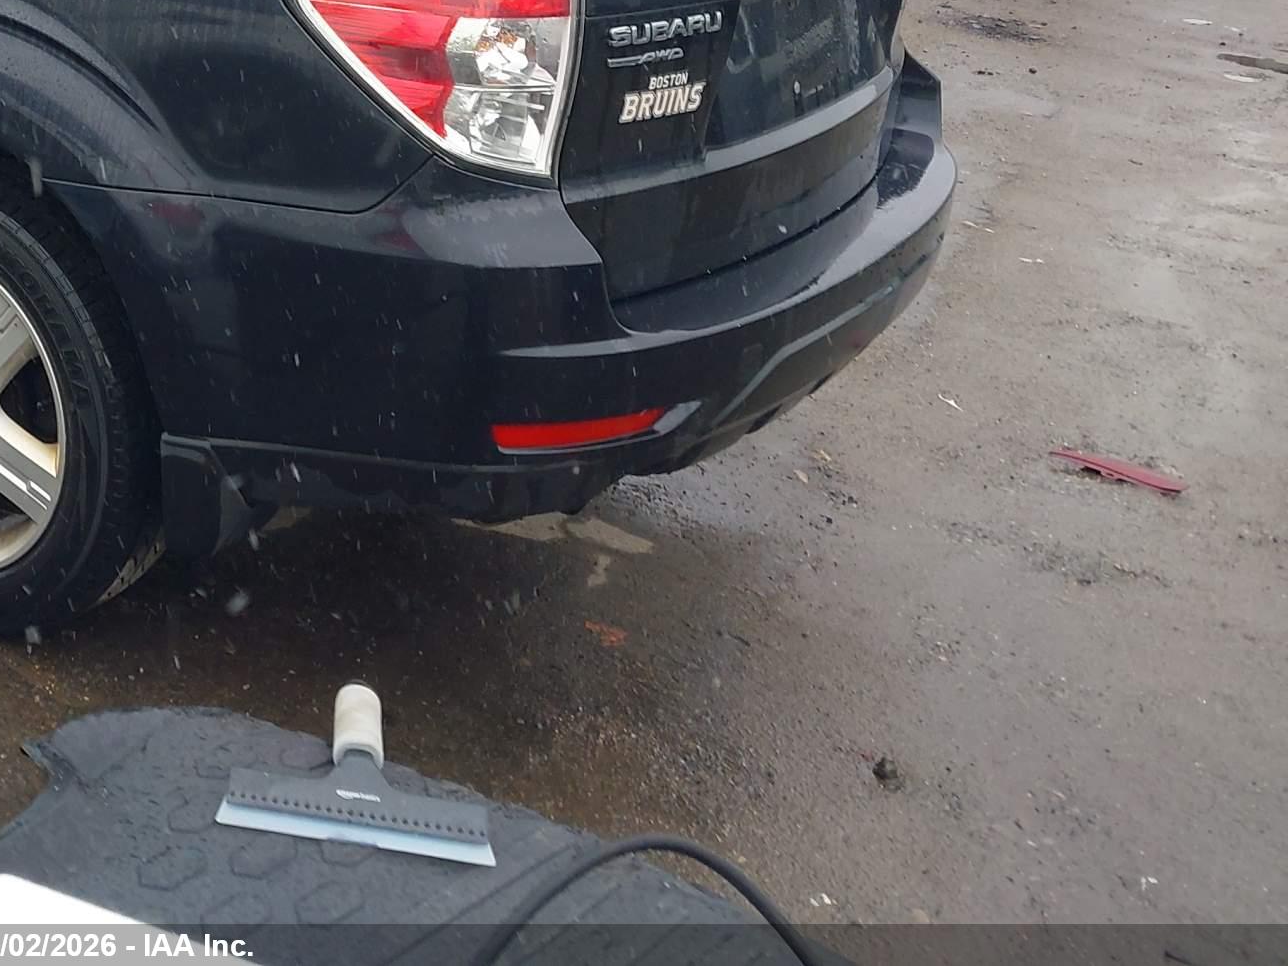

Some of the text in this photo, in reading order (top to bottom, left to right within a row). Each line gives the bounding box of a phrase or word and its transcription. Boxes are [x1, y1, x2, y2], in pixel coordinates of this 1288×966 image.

[608, 10, 723, 48] SUBARU
[638, 47, 685, 65] AWD
[648, 71, 690, 90] BOSTON
[618, 81, 707, 124] BRUINS
